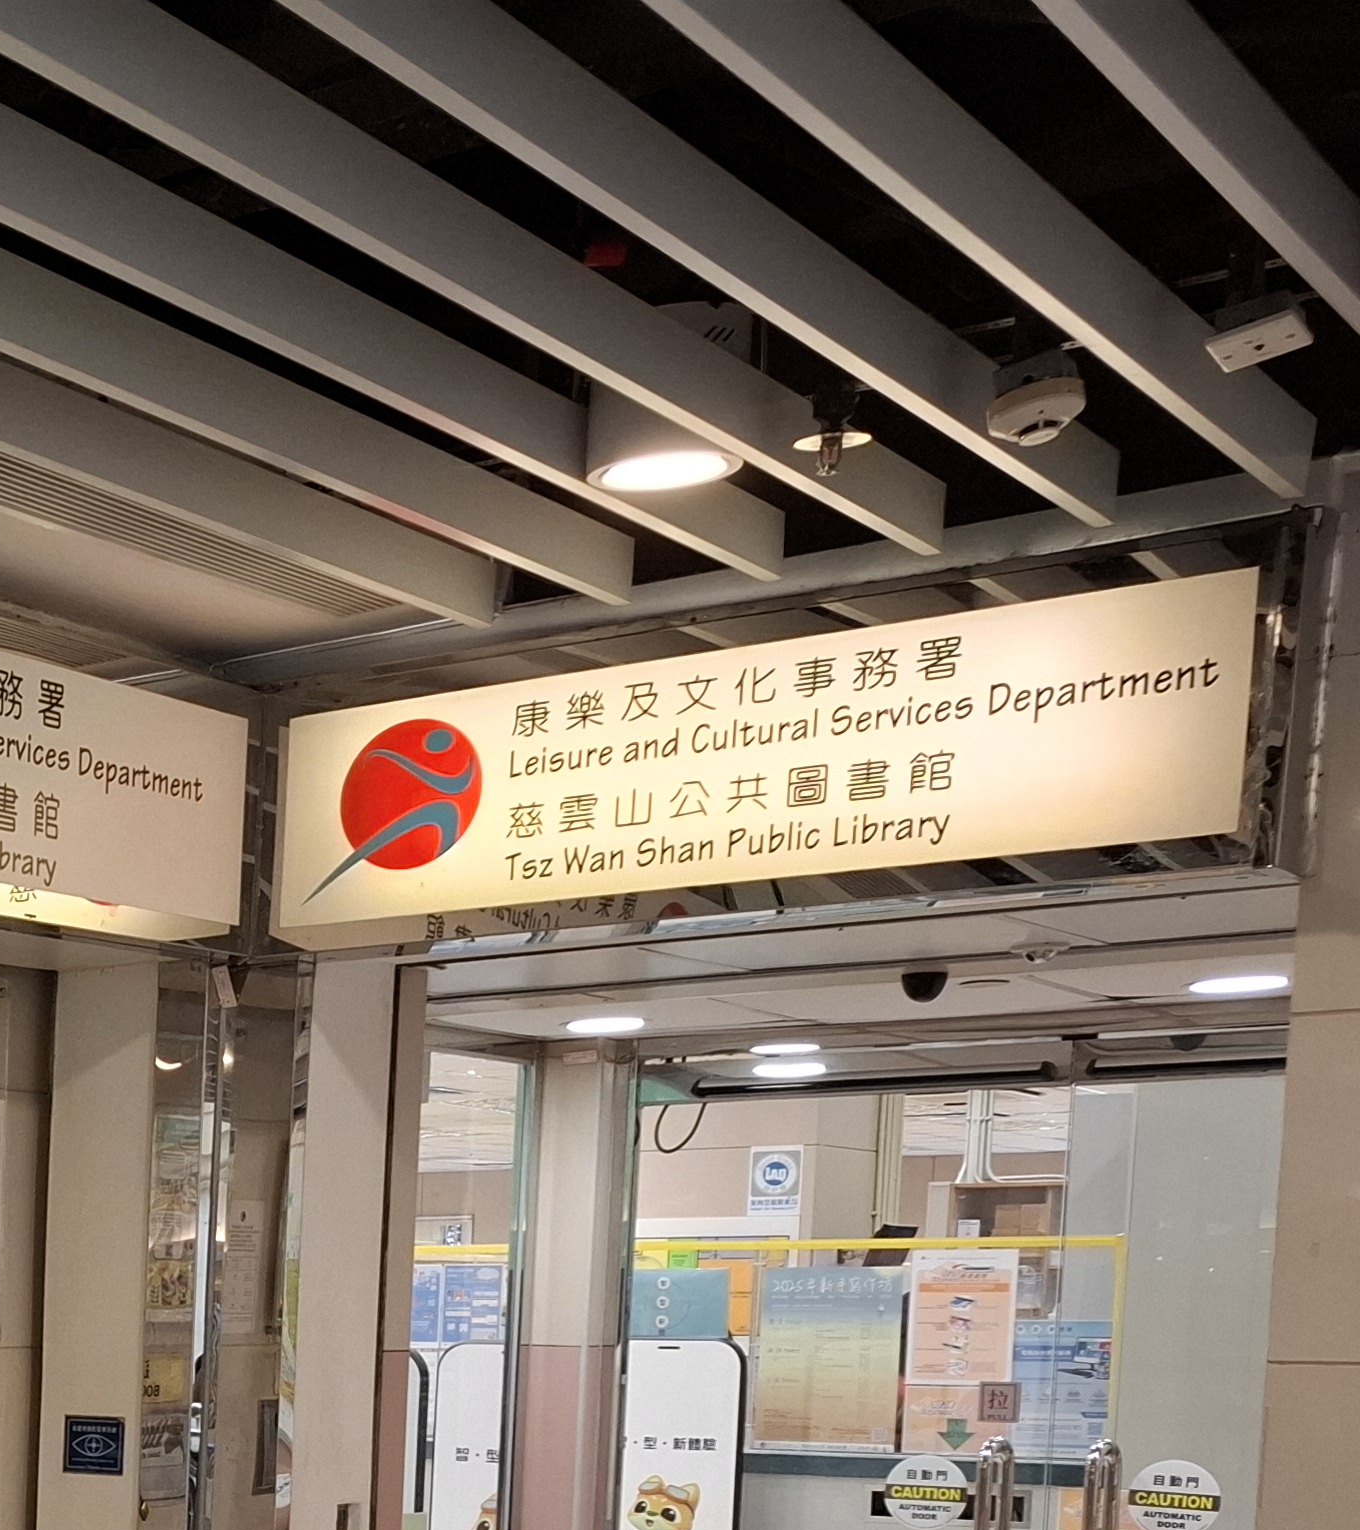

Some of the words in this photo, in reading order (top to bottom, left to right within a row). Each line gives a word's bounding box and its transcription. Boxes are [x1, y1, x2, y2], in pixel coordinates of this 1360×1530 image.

[511, 635, 963, 738] 康樂及文化事務署
[509, 744, 614, 779] Leisure
[623, 726, 680, 764] and
[691, 707, 819, 755] Cultural
[830, 695, 974, 736] Services
[988, 657, 1221, 724] Department
[78, 745, 204, 804] Department
[505, 748, 956, 839] 慈雲山公共圖書館
[504, 852, 555, 881] Tsz
[563, 843, 625, 876] Wan
[635, 835, 715, 869] Shan
[726, 820, 822, 859] Public
[832, 812, 951, 848] Library
[987, 1388, 1009, 1410] 拉
[906, 1468, 949, 1482] 自動門
[1152, 1473, 1200, 1489] 自動門
[890, 1485, 963, 1501] CAUTION
[1134, 1491, 1215, 1510] CAUTION
[898, 1503, 953, 1513] AUTOMATIC
[911, 1512, 938, 1520] DOOR
[1142, 1510, 1203, 1522] AUTOMATIC
[1156, 1520, 1187, 1530] DOOR
